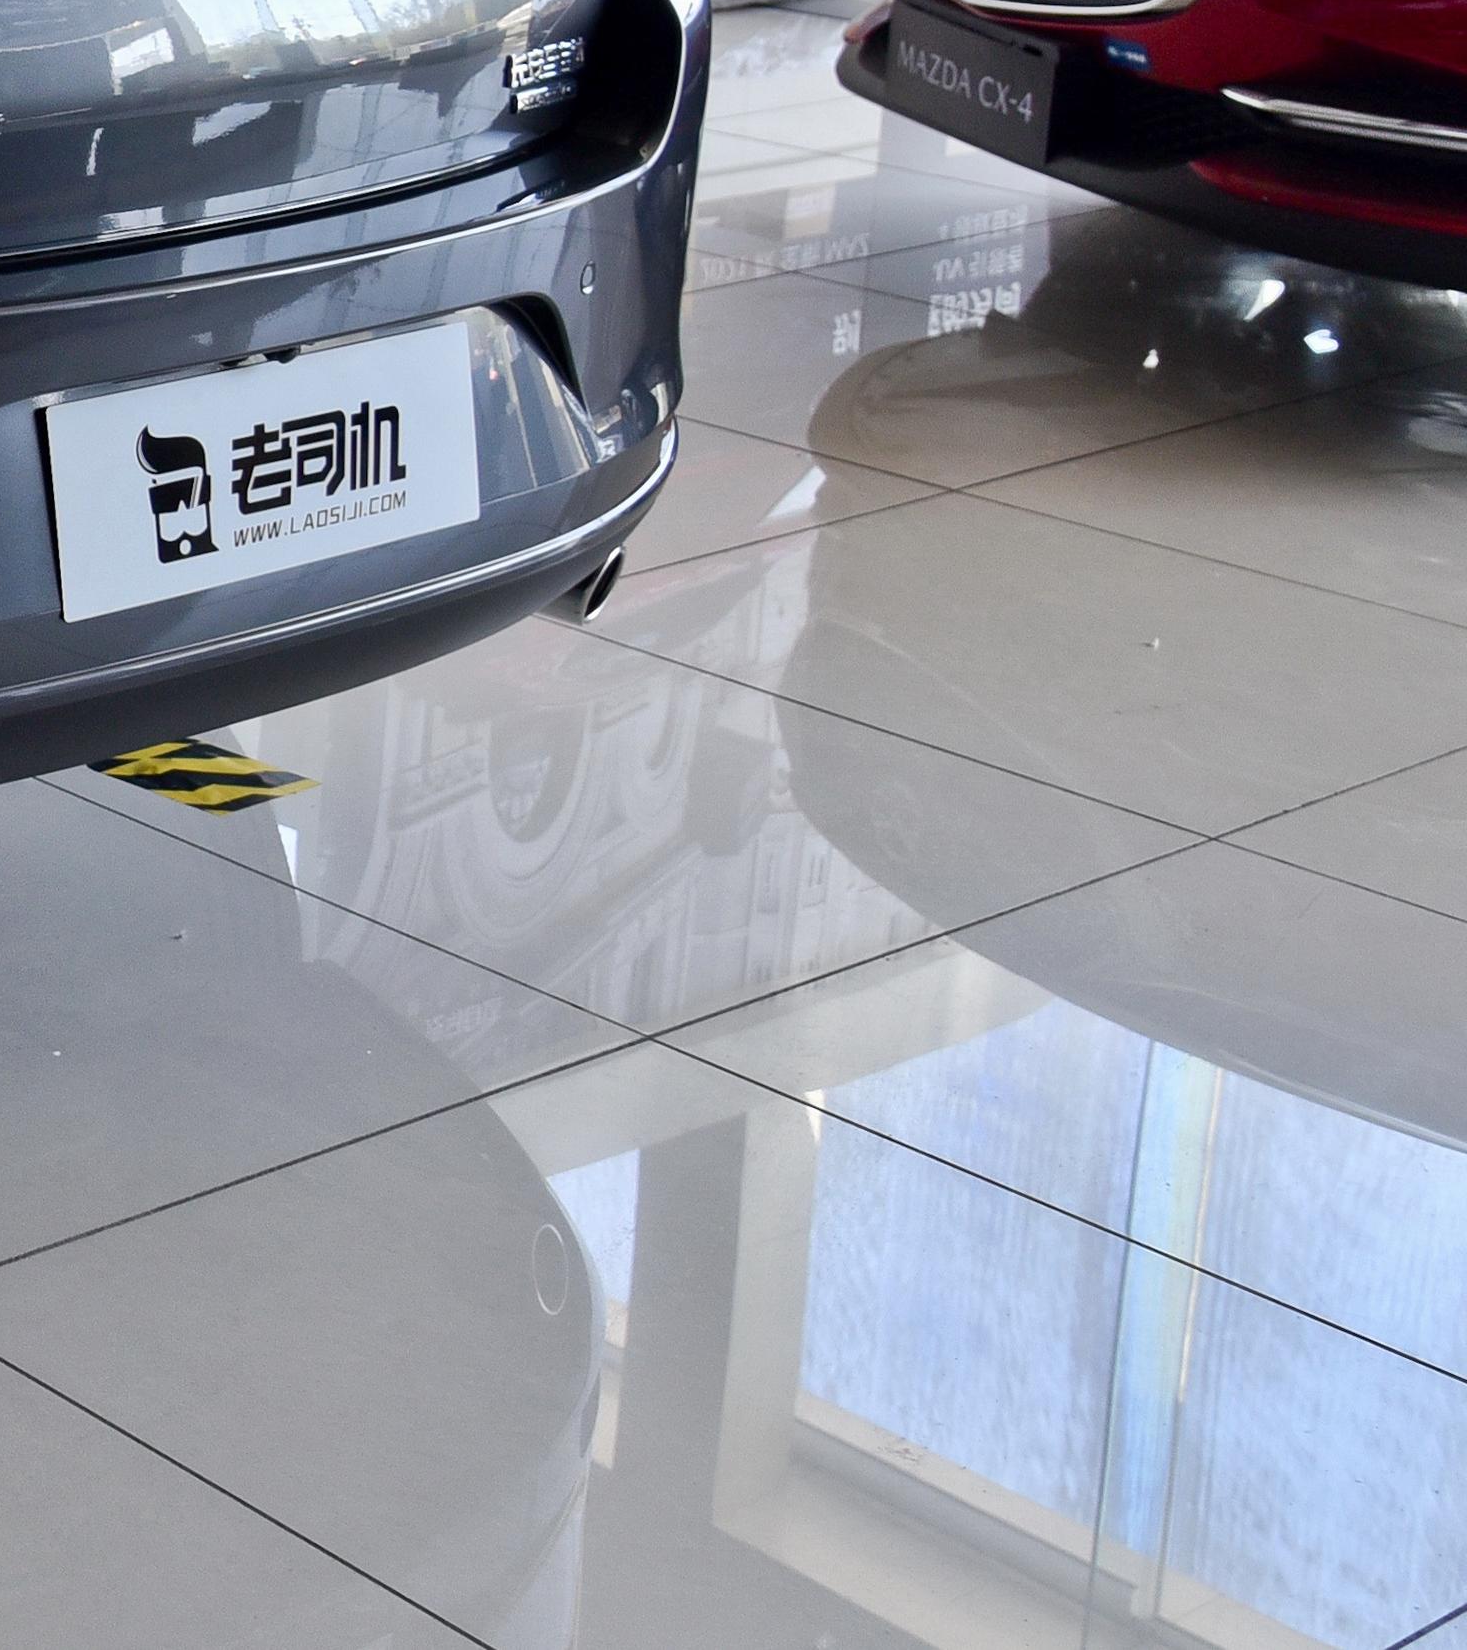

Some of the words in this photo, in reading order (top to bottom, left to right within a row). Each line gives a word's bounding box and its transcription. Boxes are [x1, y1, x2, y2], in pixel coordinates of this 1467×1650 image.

[897, 40, 972, 99] MAZDA
[977, 75, 1035, 125] CX-4
[231, 401, 407, 516] 老司机
[234, 490, 407, 549] WWW.LAOSIJI.COM
